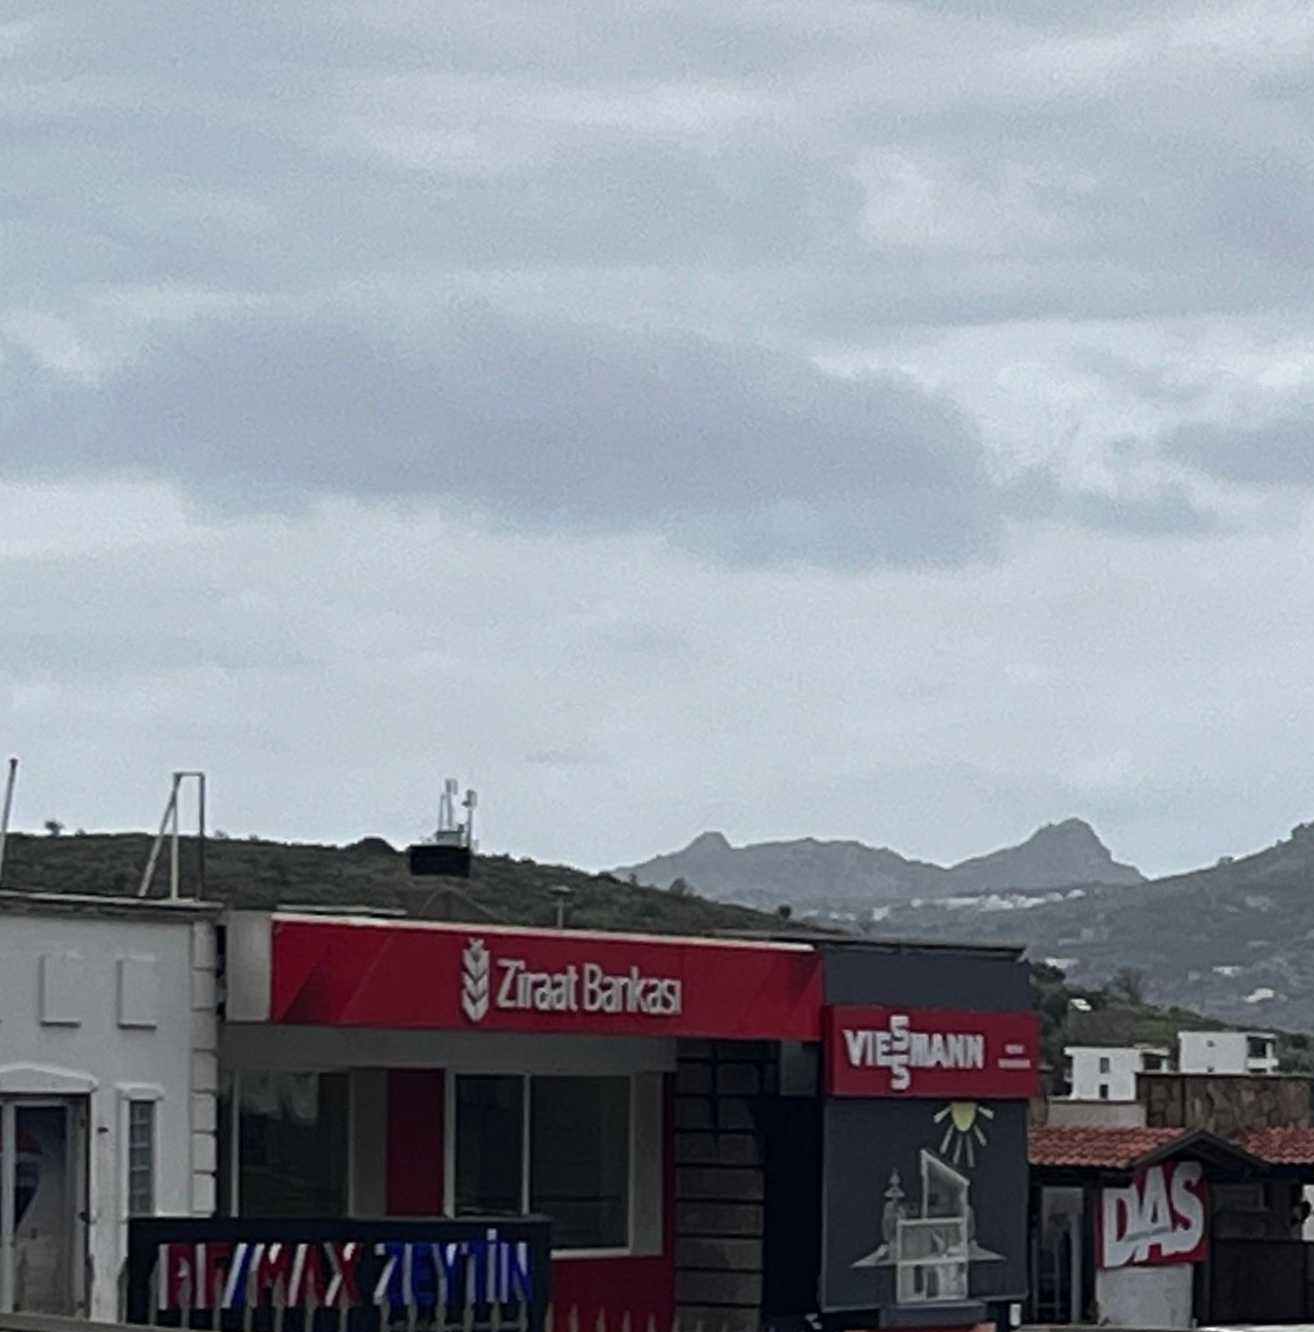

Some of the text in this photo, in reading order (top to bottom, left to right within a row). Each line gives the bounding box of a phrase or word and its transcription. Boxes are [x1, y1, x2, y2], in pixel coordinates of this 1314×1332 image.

[496, 958, 683, 1016] Ziraat Bankası
[1102, 1161, 1204, 1269] DAS
